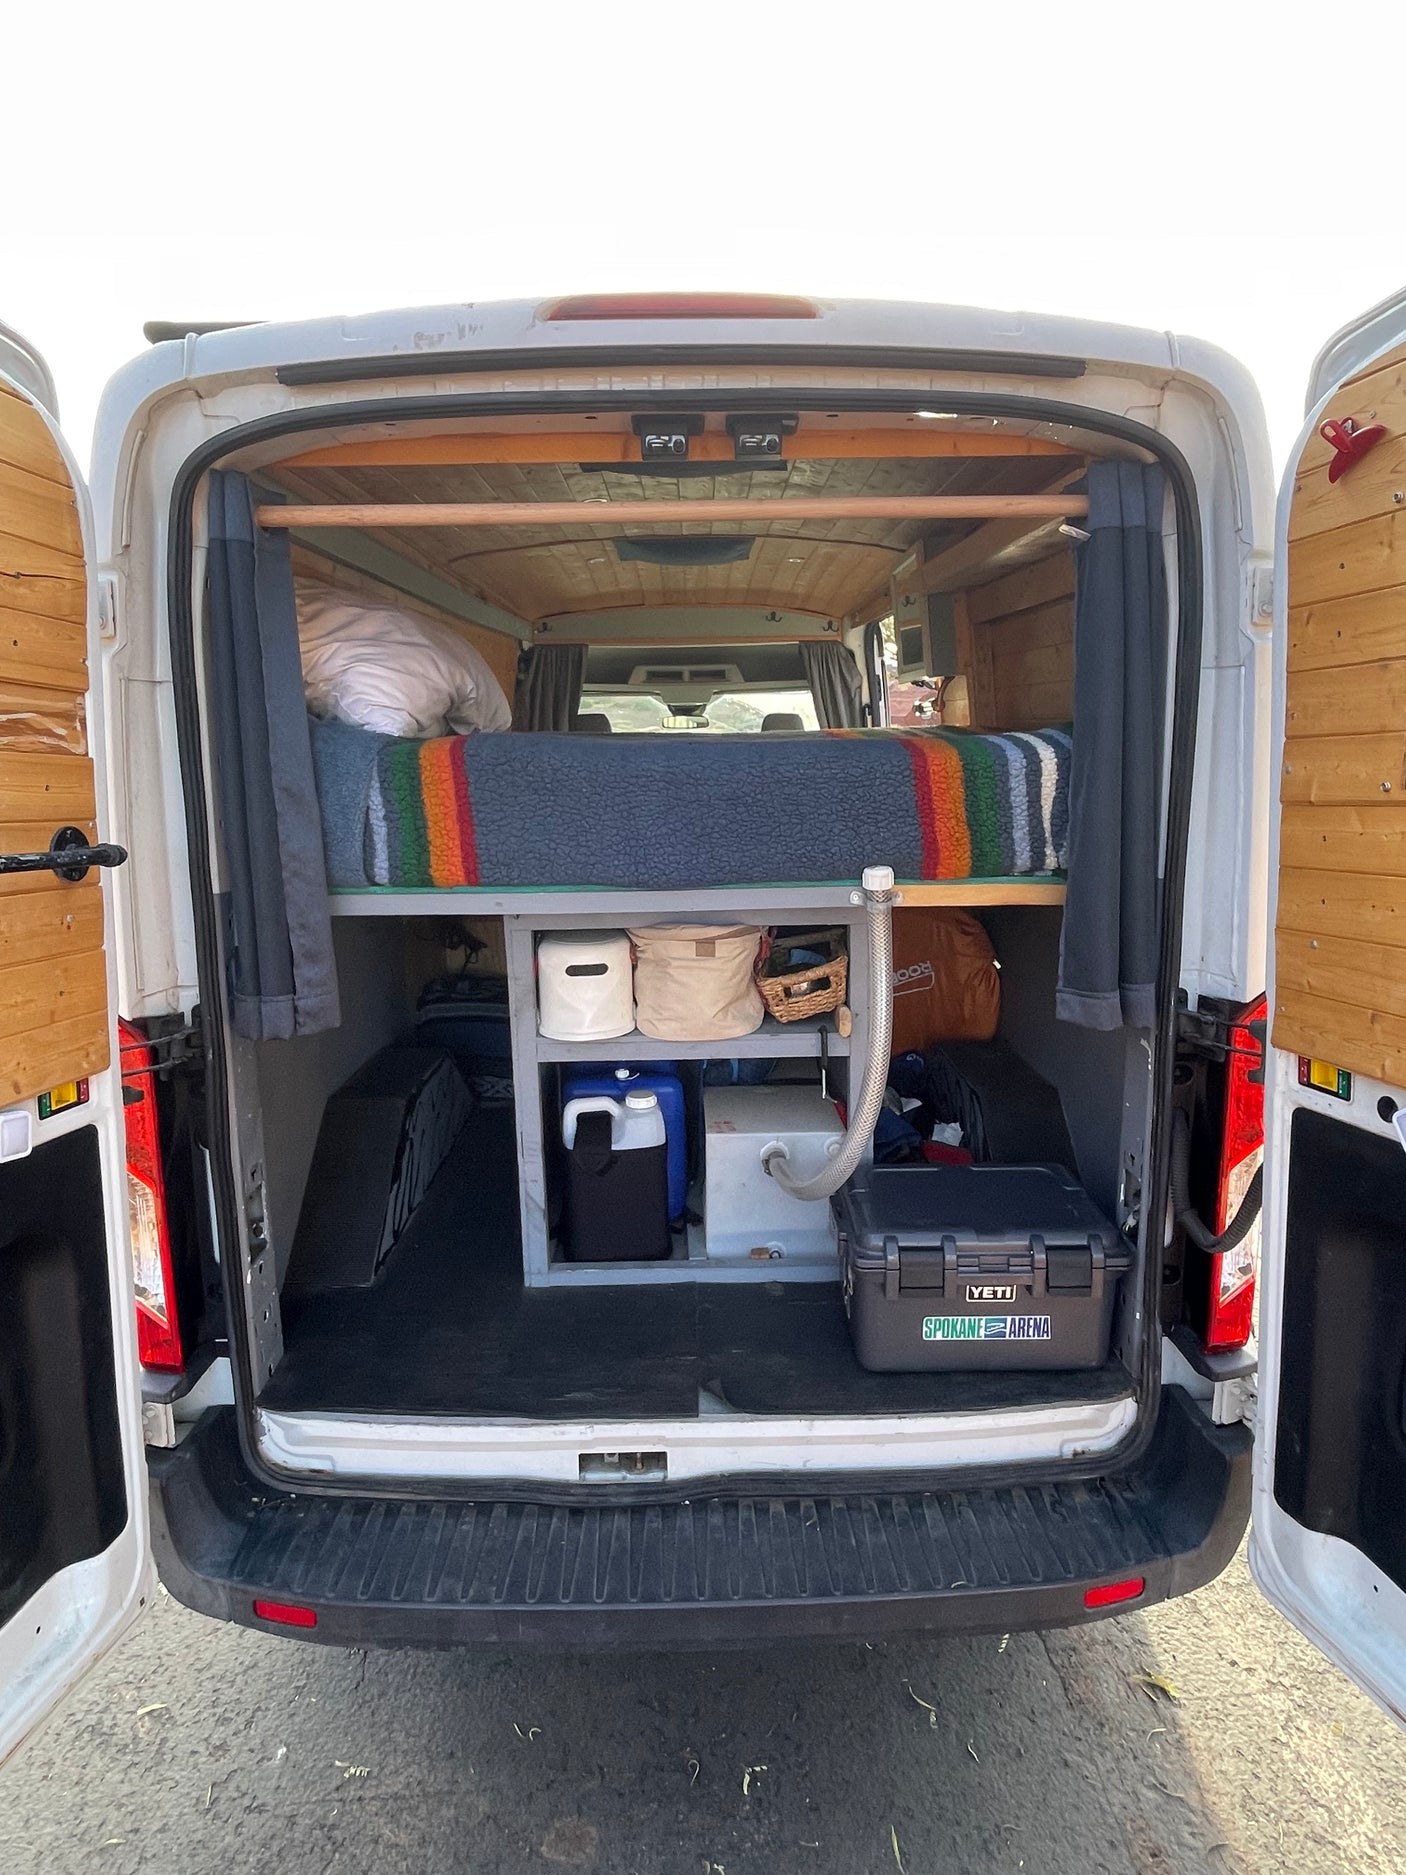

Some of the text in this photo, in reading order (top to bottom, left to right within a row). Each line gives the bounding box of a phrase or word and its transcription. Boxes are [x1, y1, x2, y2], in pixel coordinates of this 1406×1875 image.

[970, 1286, 1011, 1299] YETI
[924, 1316, 1050, 1339] SPOKANE ARENA
